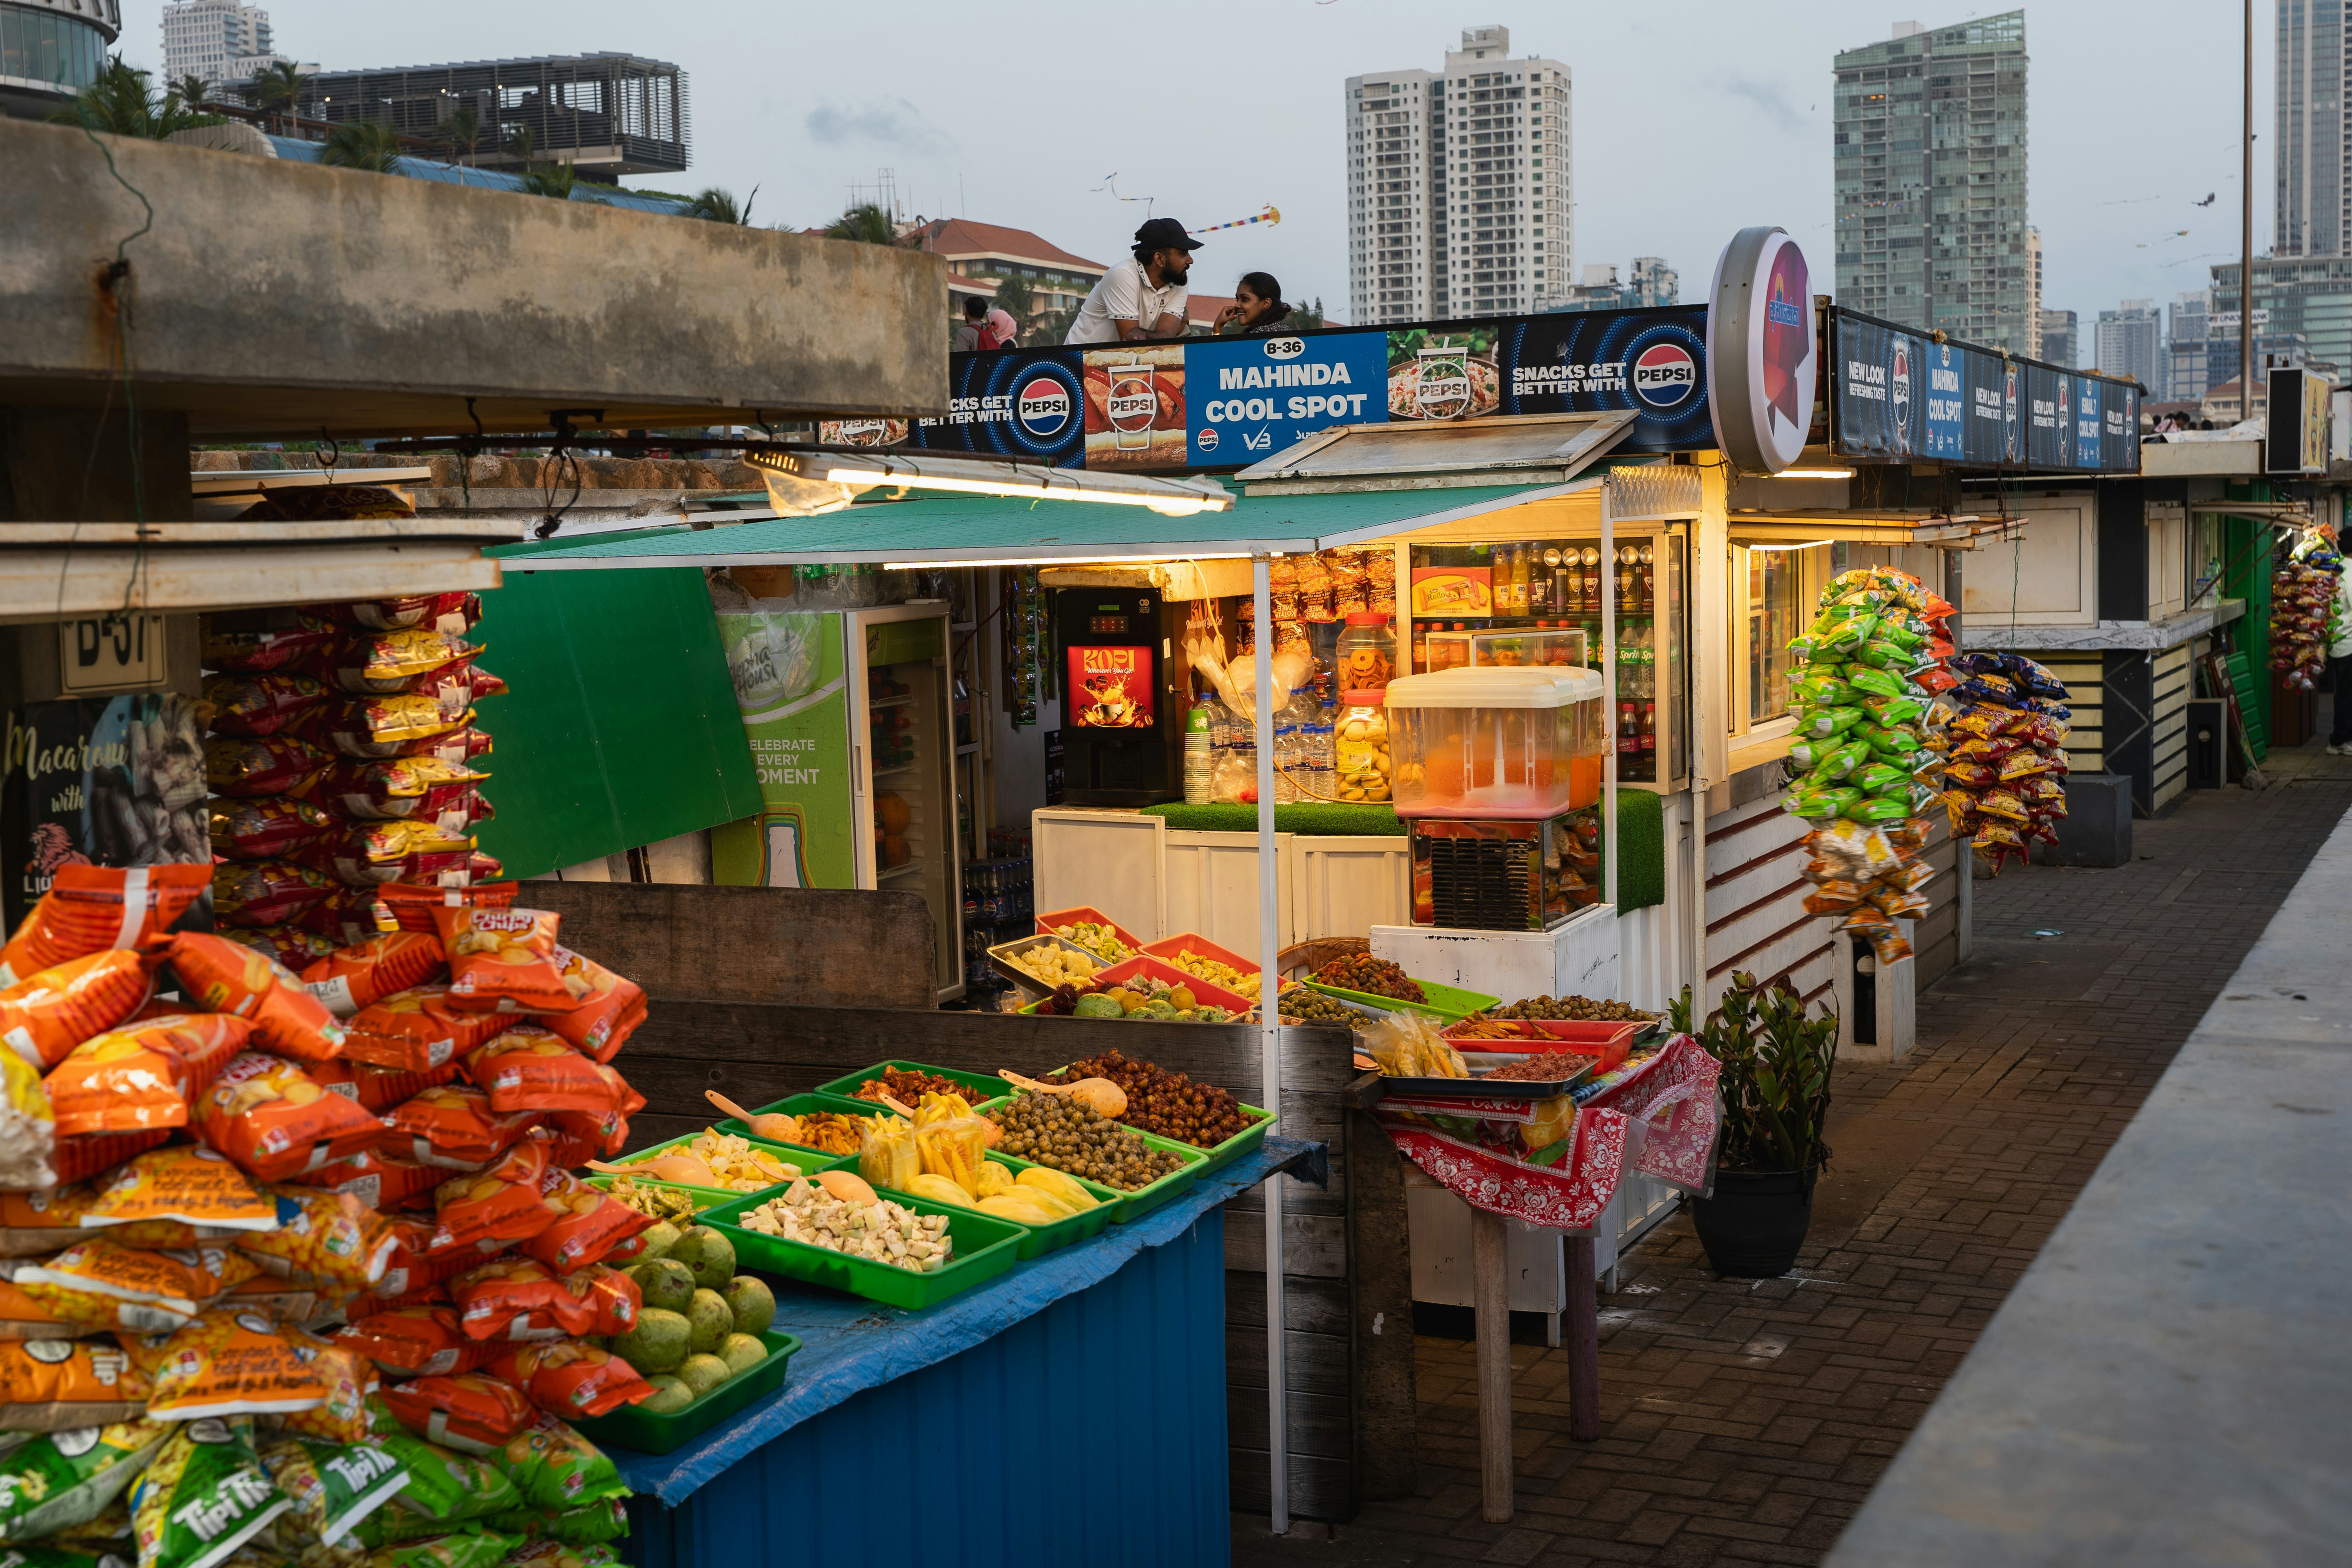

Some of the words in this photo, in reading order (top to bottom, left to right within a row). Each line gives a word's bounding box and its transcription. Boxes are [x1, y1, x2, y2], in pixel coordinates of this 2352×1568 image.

[1266, 341, 1302, 355] B-36
[1219, 362, 1351, 390] MAHINDA
[1513, 365, 1586, 381] SNACKS
[1588, 362, 1627, 378] GET
[1638, 367, 1691, 383] PEPSI
[1849, 360, 1865, 382] NEW
[1865, 364, 1885, 385] LOOK
[1513, 380, 1580, 396] BETTER
[1582, 377, 1627, 392] WITH
[1932, 368, 1959, 393] MAHINDA
[1419, 383, 1467, 397] PEPSI
[1849, 382, 1873, 400] REFRESHING
[1873, 386, 1886, 401] TASTE
[1894, 380, 1908, 398] PEPSI
[1976, 387, 1987, 404] NEW
[1987, 390, 2001, 407] LOOK
[950, 397, 980, 411] CKS
[981, 395, 1013, 409] GET
[1021, 400, 1067, 414] PEPSI
[1110, 398, 1153, 412] PEPSI
[1206, 398, 1283, 423] COOL
[1288, 393, 1367, 419] SPOT
[1929, 398, 1946, 421] COOL
[1945, 400, 1961, 422] SPOT
[2007, 401, 2016, 416] PEPSI
[2034, 399, 2043, 413] NEW
[2043, 400, 2055, 416] LOOK
[977, 409, 1013, 422] WITH
[1976, 405, 1993, 419] REFRESHING
[1992, 408, 2001, 420] TASTE
[2059, 410, 2067, 422] PEPSI
[2114, 412, 2123, 425] LOOK
[2034, 415, 2048, 427] REFRESHING
[2079, 420, 2089, 438] COOL
[2089, 421, 2099, 438] SPOT
[1427, 592, 1445, 601] Rollo
[1186, 618, 1206, 630] Wherever
[1206, 617, 1215, 629] Yo
[1281, 622, 1295, 630] MEE
[1083, 649, 1135, 672] KOPI
[2038, 714, 2049, 731] Class
[5, 709, 129, 781] Macaroni
[749, 739, 815, 751] ELEBRATE
[757, 754, 800, 765] EVERY
[757, 769, 820, 784] OMENT
[51, 784, 88, 813] with
[24, 875, 56, 895] LIO
[478, 920, 529, 933] Chips
[326, 1450, 378, 1494] Tipi
[172, 1490, 244, 1543] Tipi
